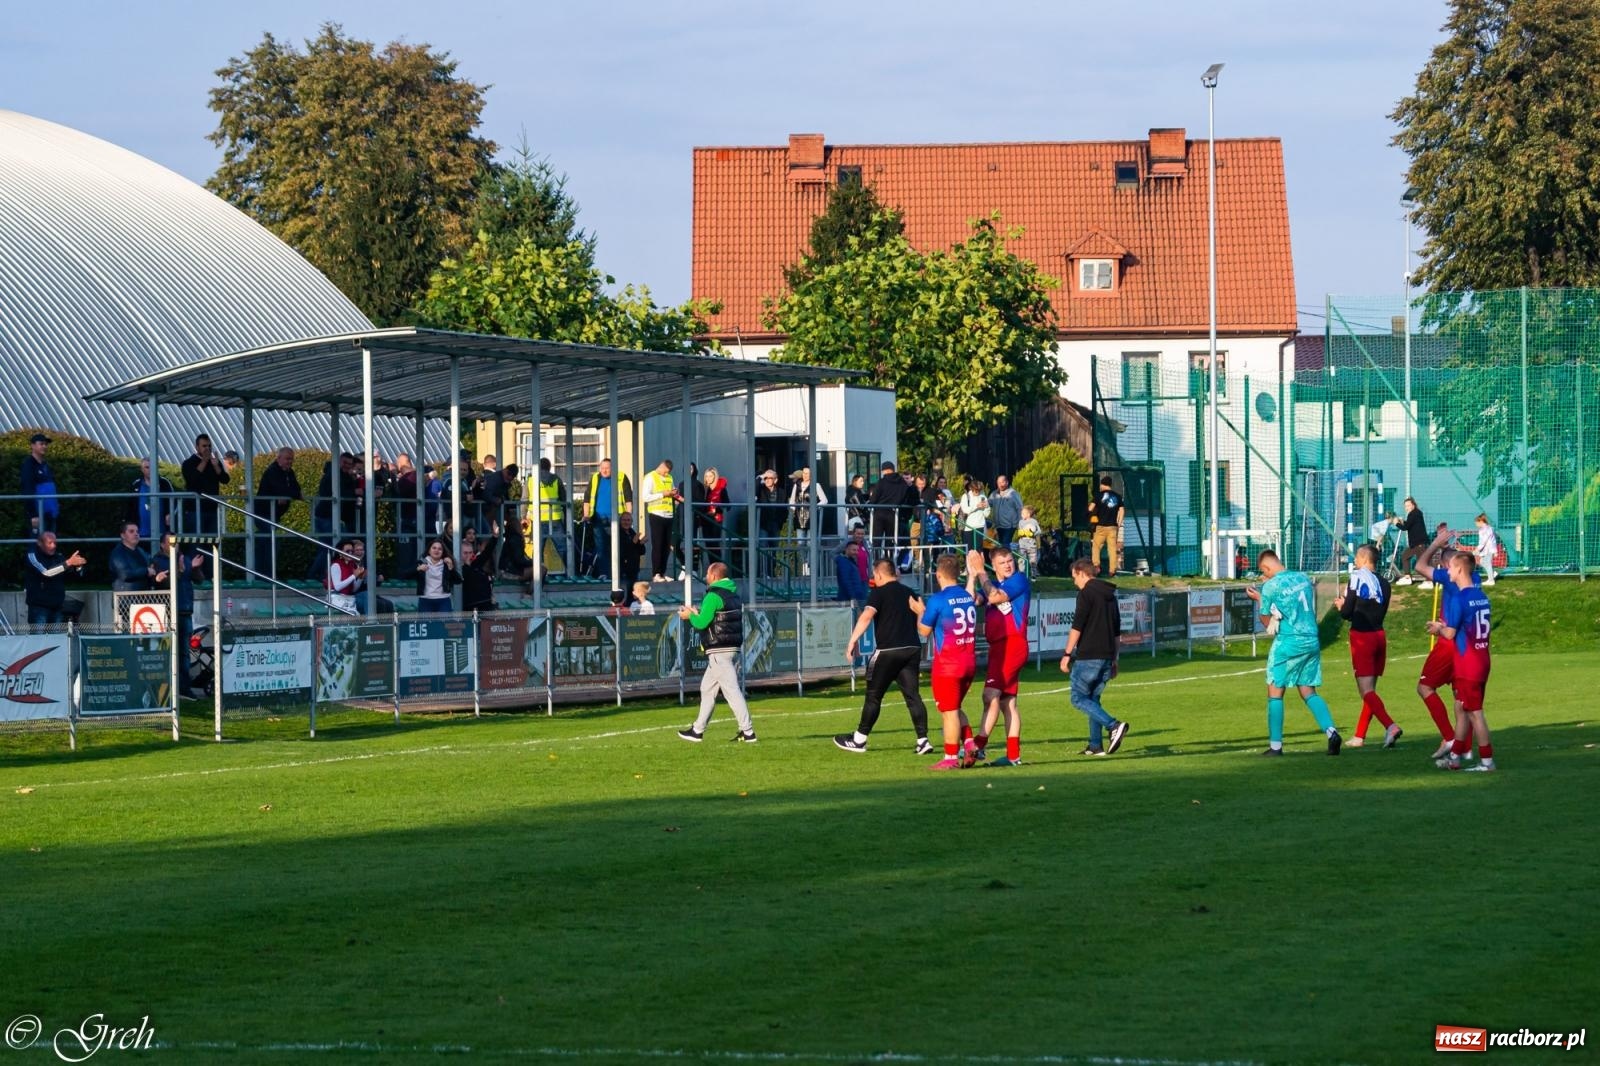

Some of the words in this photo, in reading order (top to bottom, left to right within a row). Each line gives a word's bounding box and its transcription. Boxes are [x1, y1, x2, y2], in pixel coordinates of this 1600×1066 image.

[1298, 590, 1309, 612] 1
[409, 623, 427, 637] ELIS
[953, 606, 976, 635] 39
[1475, 609, 1490, 639] 15
